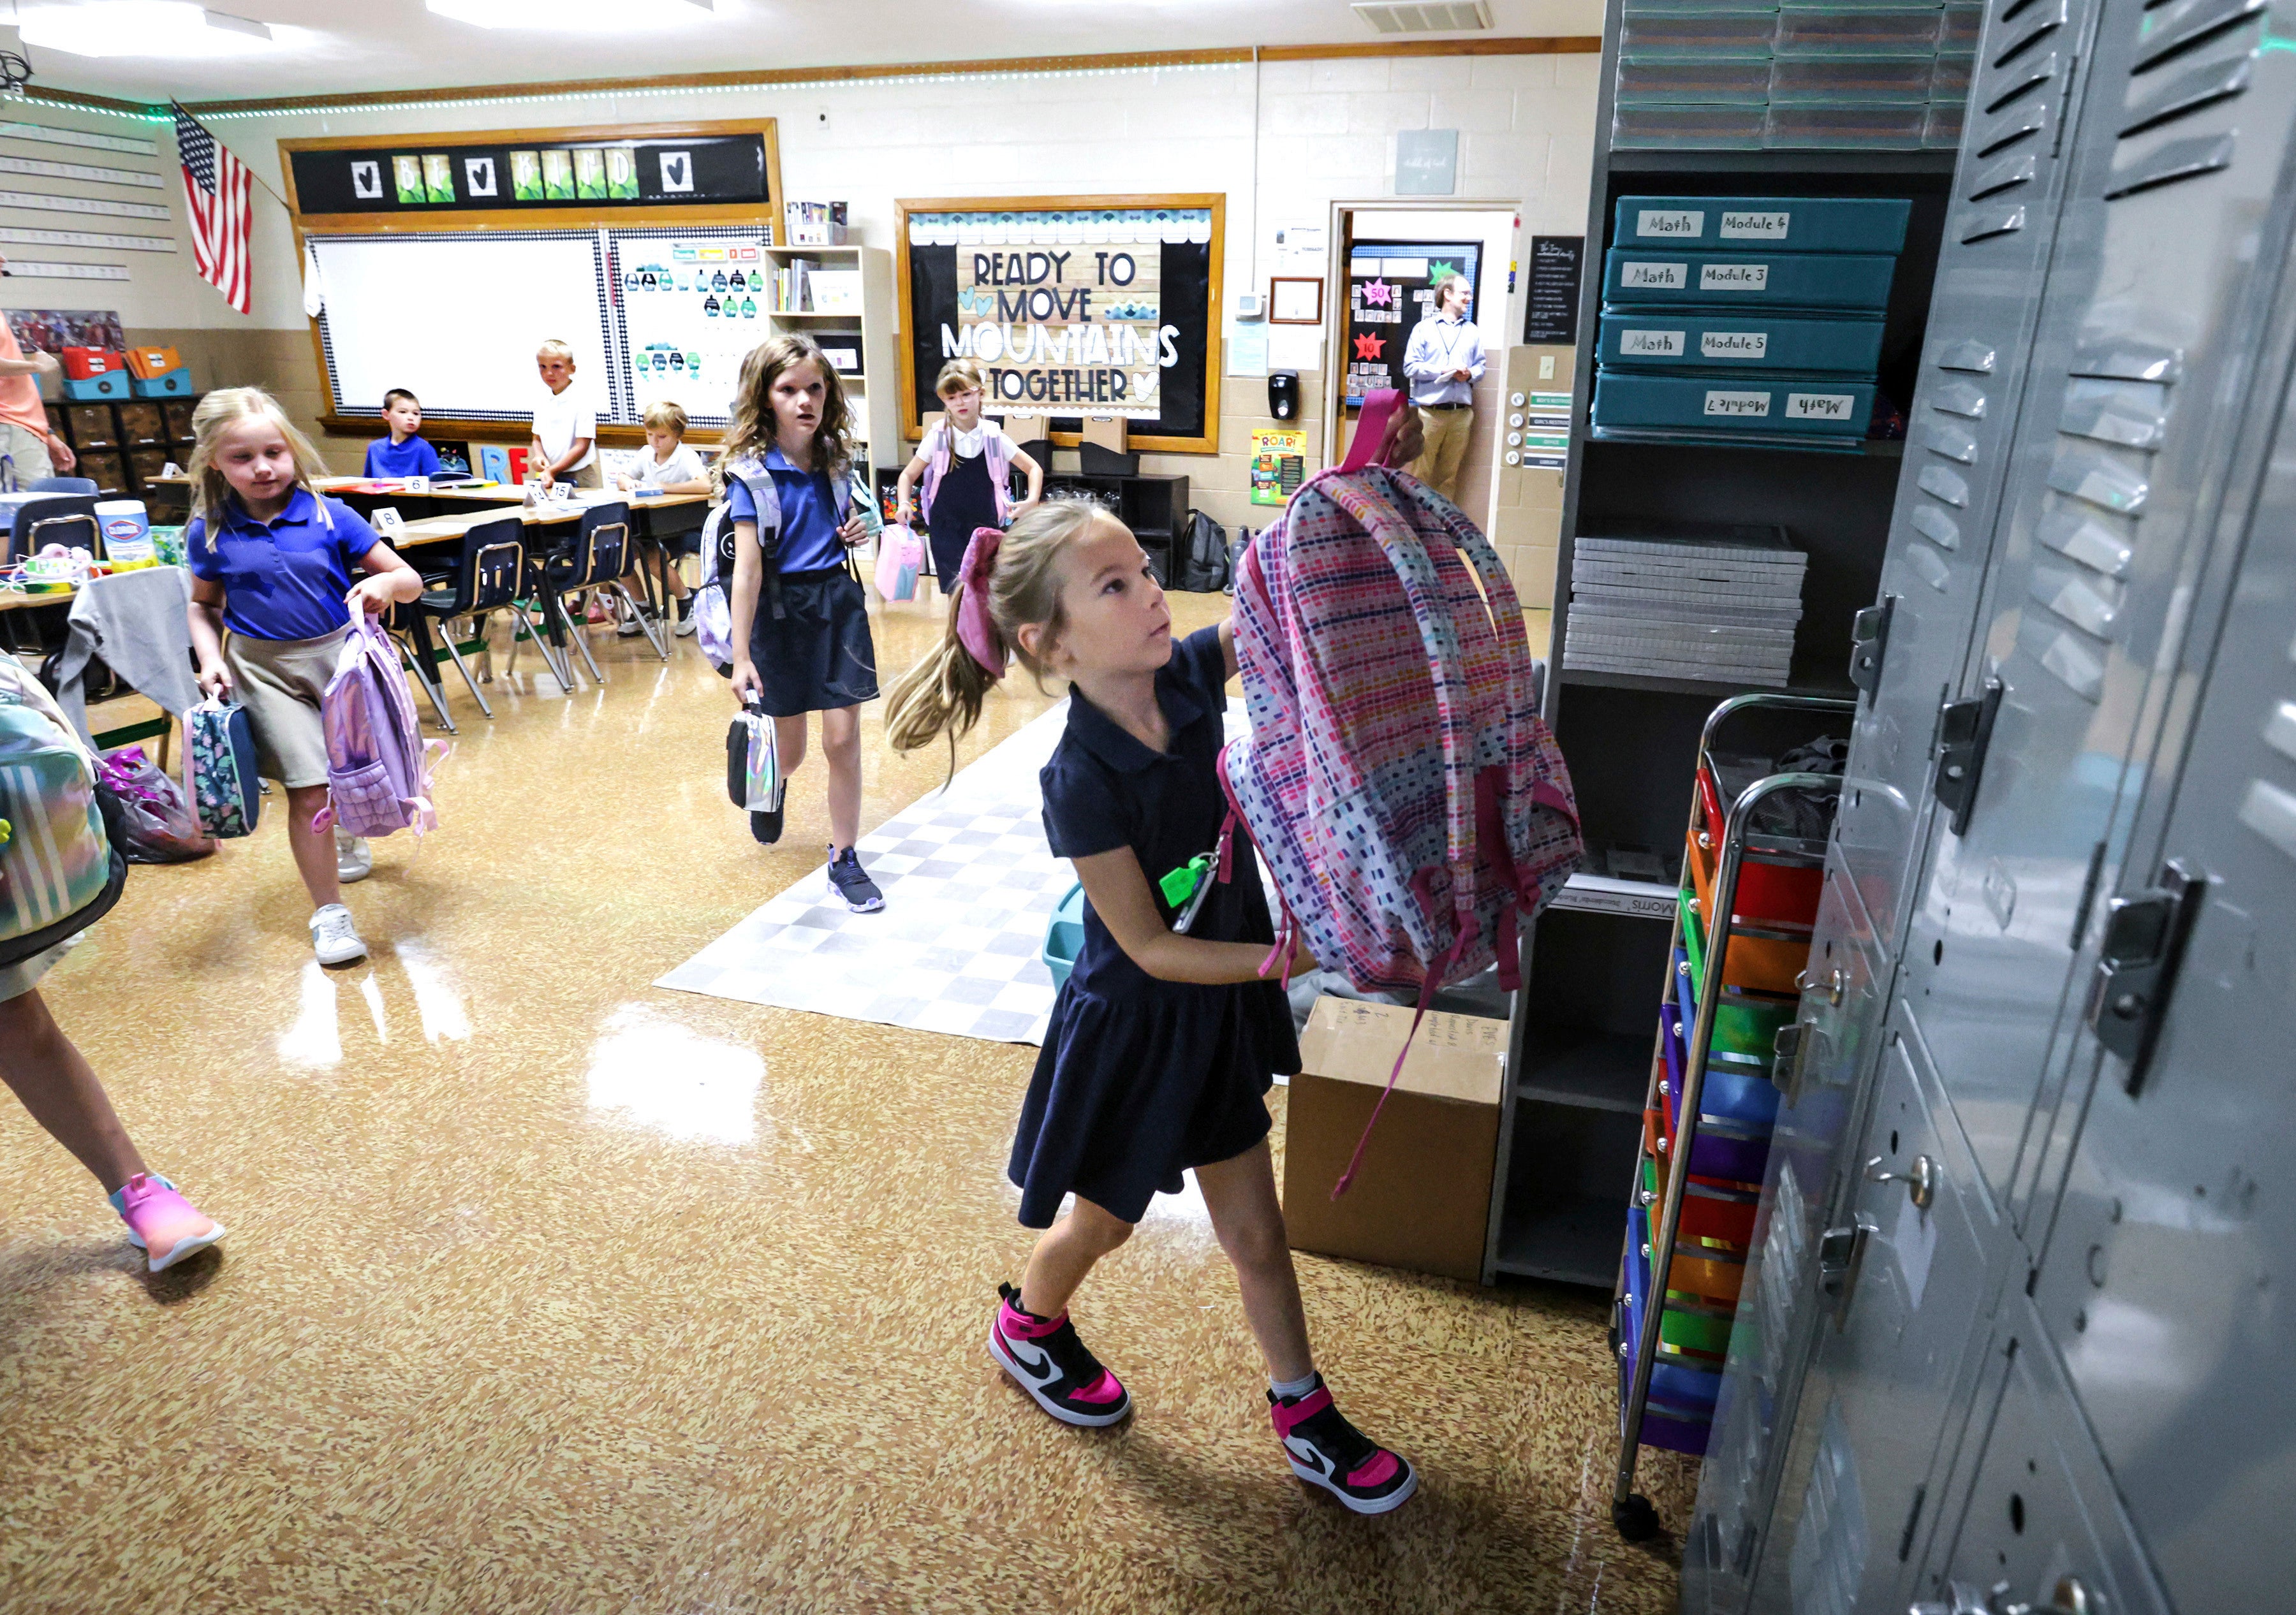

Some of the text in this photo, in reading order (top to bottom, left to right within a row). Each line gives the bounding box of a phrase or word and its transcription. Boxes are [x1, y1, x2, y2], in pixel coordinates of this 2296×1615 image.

[518, 150, 630, 187] KIND
[1649, 215, 1786, 231] Math Module 4
[974, 251, 1135, 286] READY TO
[1631, 268, 1764, 283] Math Module 3
[1371, 288, 1384, 298] 50
[997, 288, 1091, 323] MOVE
[941, 321, 1181, 368] MOUNTAINS
[1364, 343, 1374, 353] 10
[1630, 335, 1764, 351] Math Module 5
[989, 368, 1127, 402] TOGETHER
[1707, 399, 1844, 414] Math Module 7
[1262, 436, 1296, 448] ROAR!
[412, 479, 420, 489] 6
[556, 486, 566, 497] 15
[384, 513, 395, 525] 8
